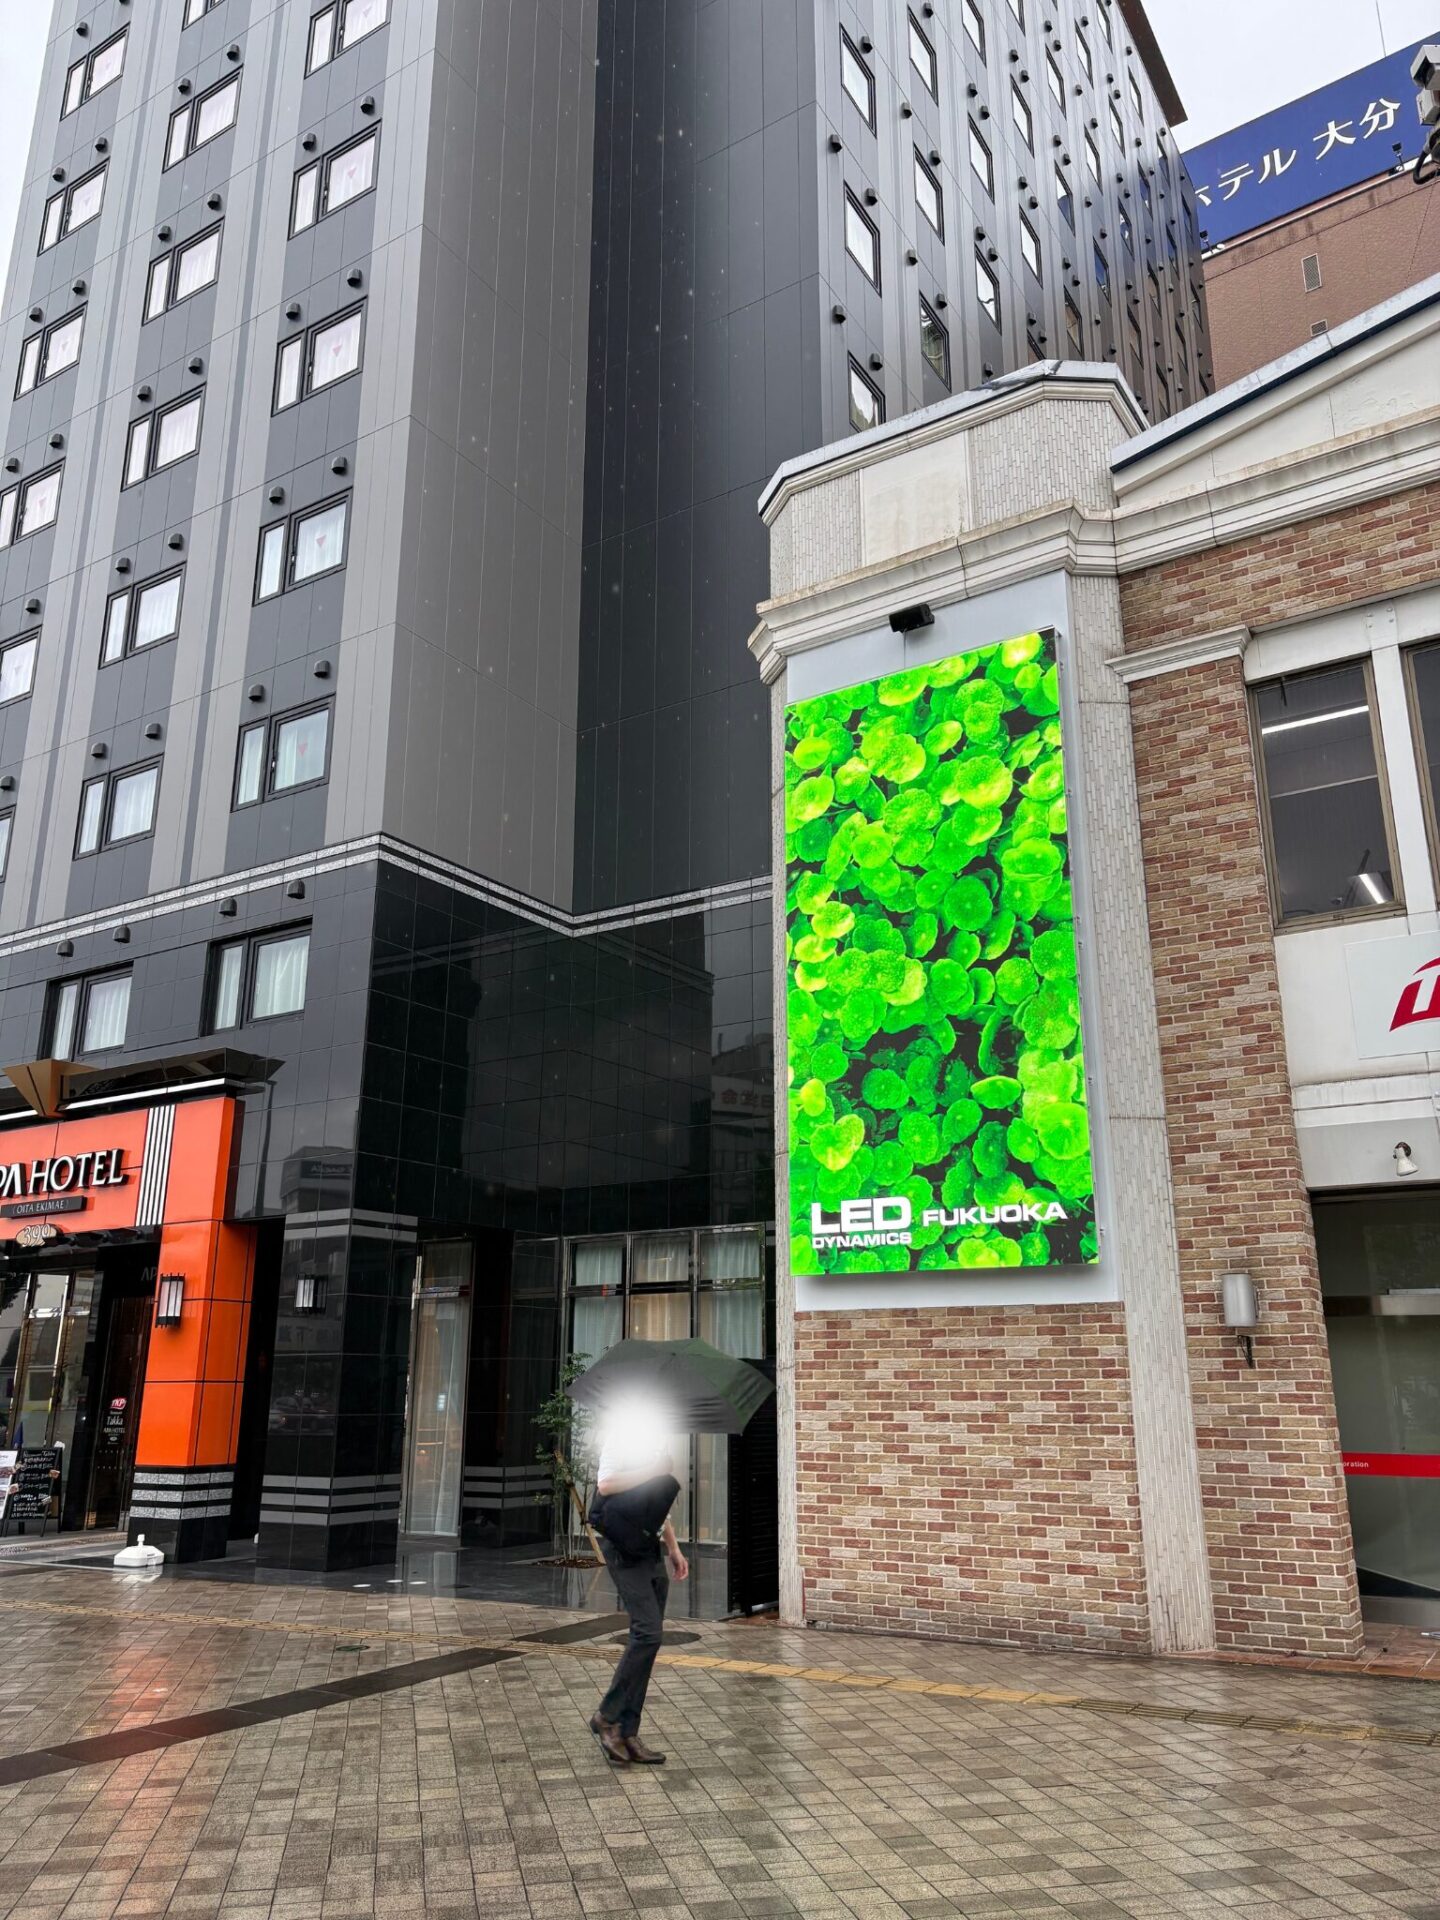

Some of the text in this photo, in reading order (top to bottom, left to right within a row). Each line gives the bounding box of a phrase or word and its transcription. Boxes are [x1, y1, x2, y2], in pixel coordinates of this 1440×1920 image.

[1312, 98, 1401, 160] 大分
[29, 1149, 124, 1194] HOTEL
[811, 1196, 1068, 1234] LED FUKUOKA
[812, 1231, 912, 1249] DYNAMICS
